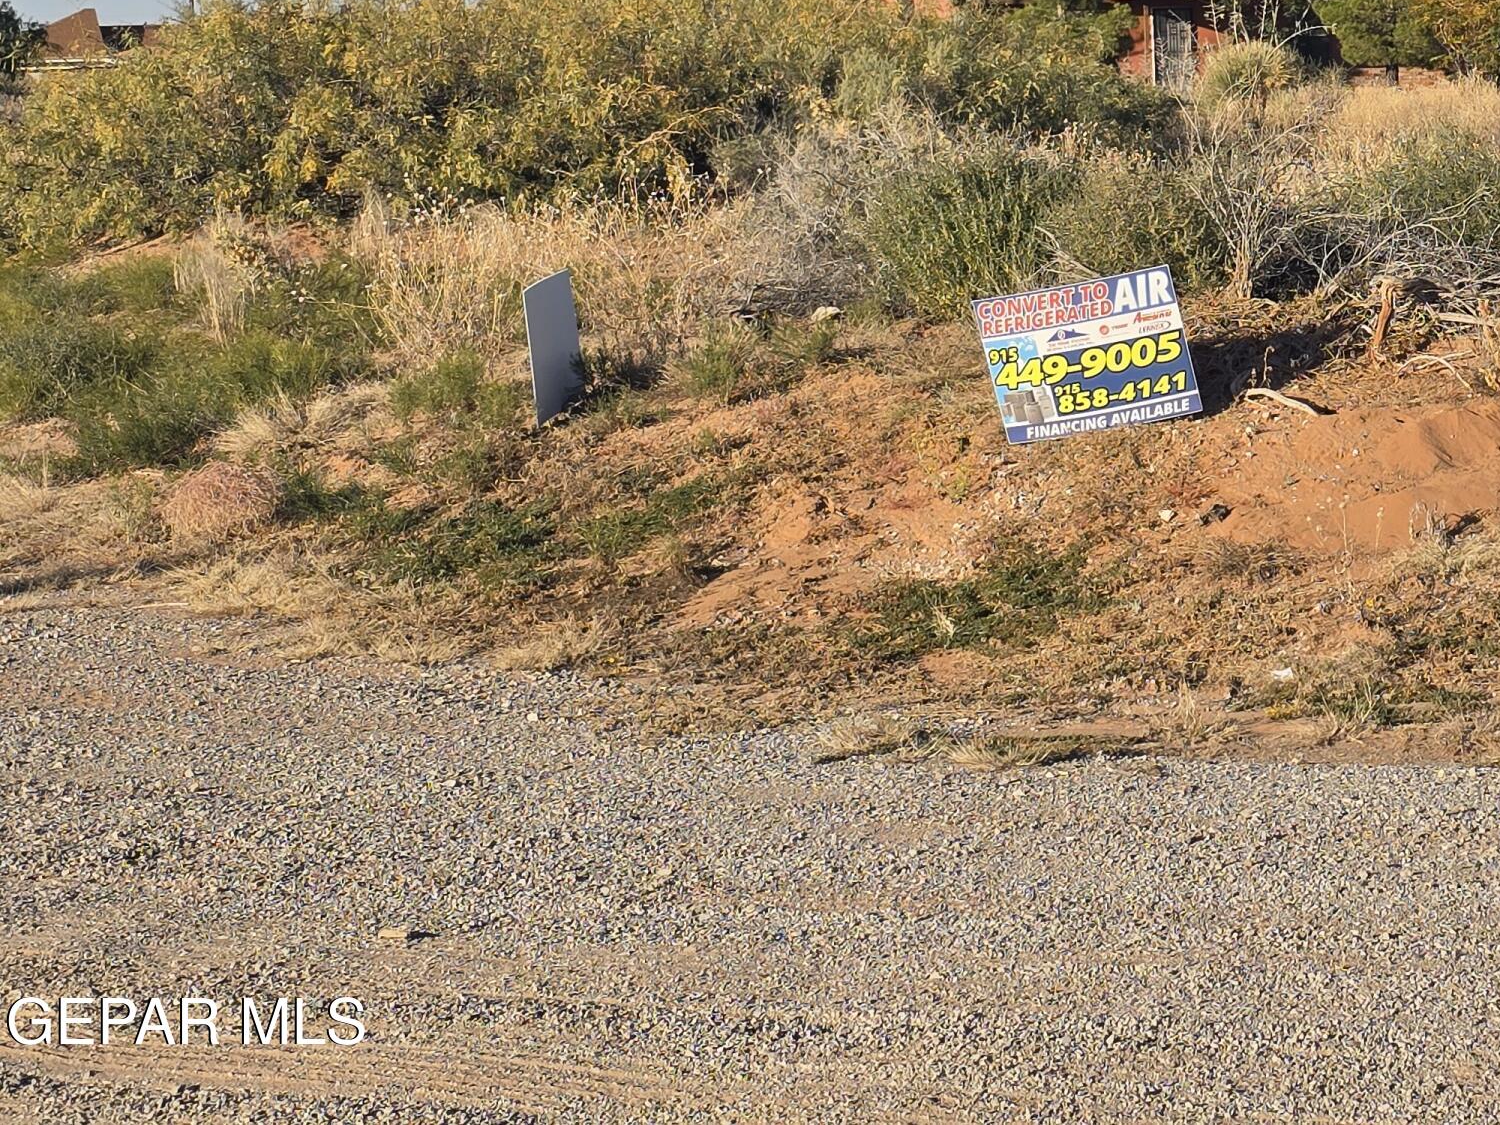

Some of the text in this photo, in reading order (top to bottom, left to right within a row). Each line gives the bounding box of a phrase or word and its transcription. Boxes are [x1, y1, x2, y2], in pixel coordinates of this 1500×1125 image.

[978, 270, 1173, 319] CONVERT TO AIR
[983, 299, 1113, 335] REFRIGERATED
[989, 347, 1018, 364] 915
[996, 331, 1181, 390] 449-9005
[1055, 383, 1081, 397] 915
[1058, 372, 1187, 414] 858-4141
[1027, 399, 1189, 439] FINANCING AVAILABLE
